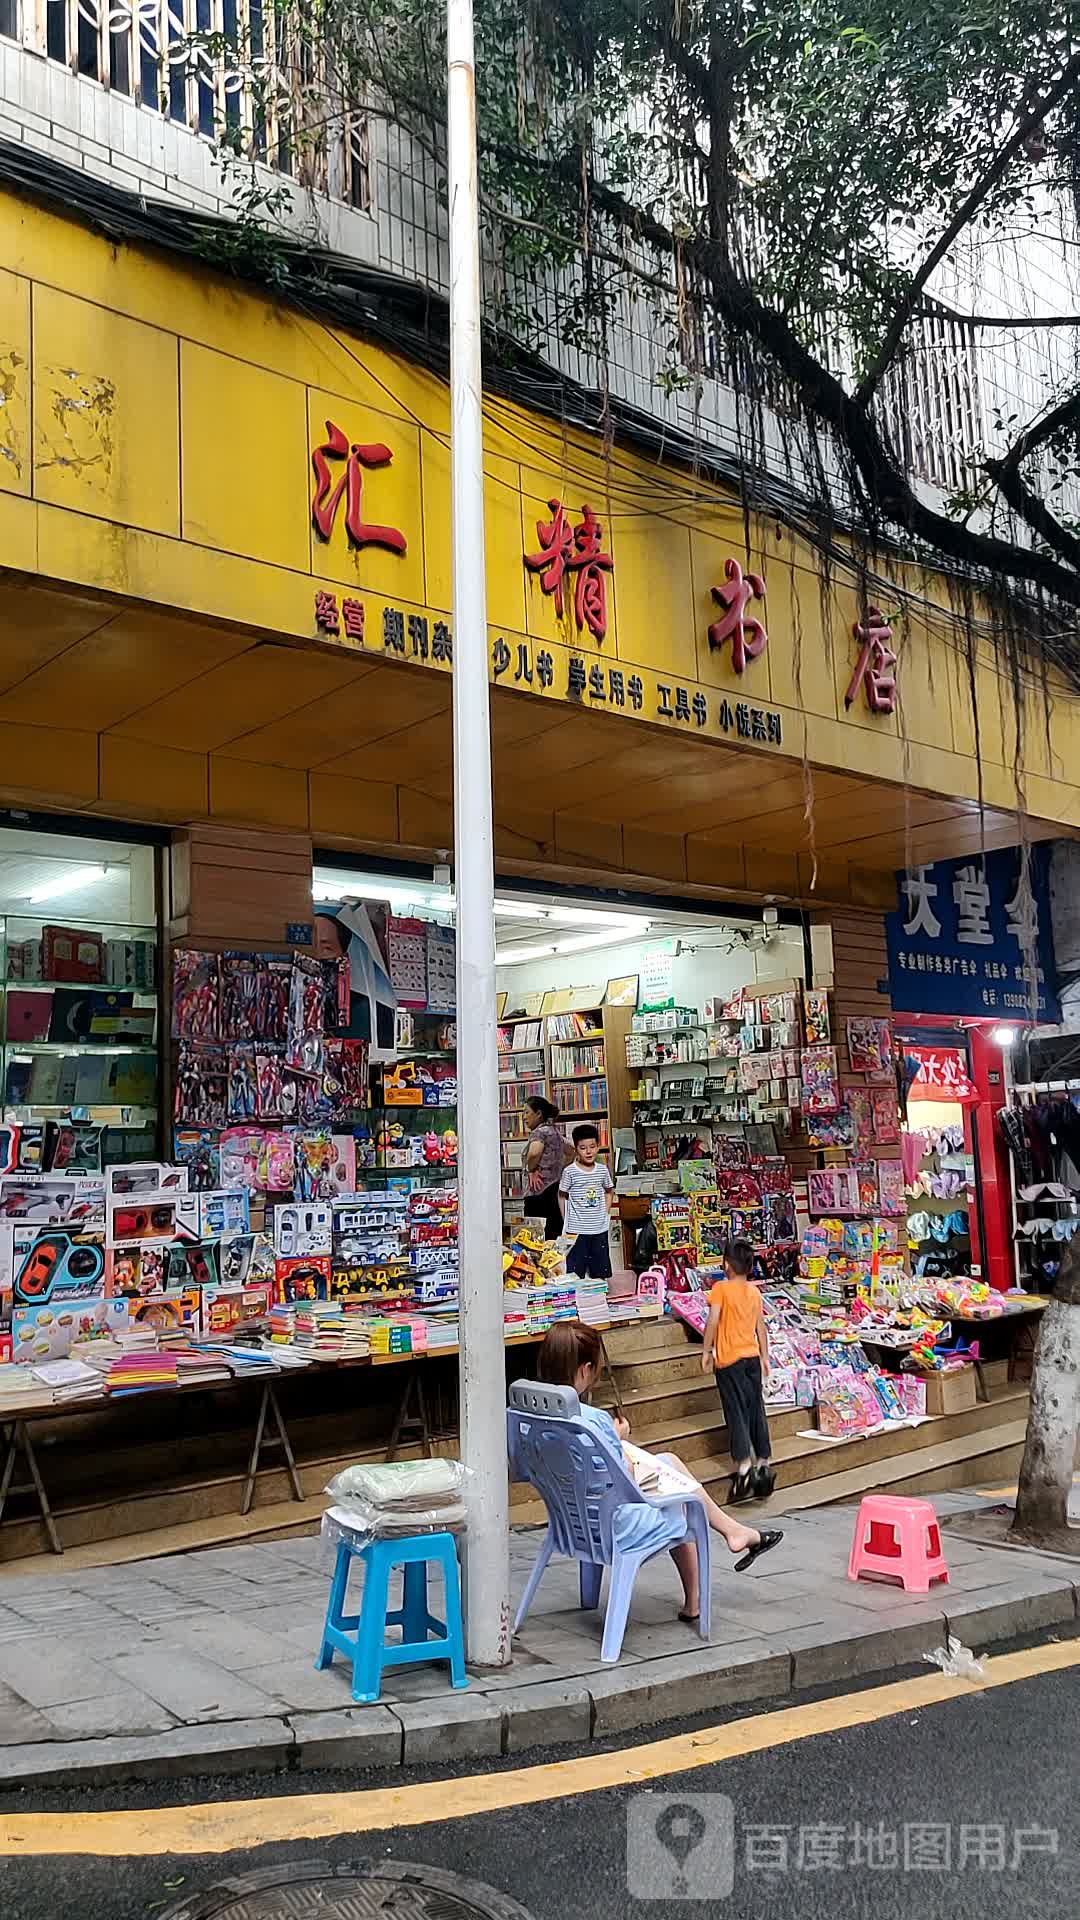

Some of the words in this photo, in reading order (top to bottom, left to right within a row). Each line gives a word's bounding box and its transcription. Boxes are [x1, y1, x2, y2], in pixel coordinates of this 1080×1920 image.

[315, 590, 364, 642] 经营
[383, 607, 453, 664] 期刊杂
[492, 637, 553, 687] 少儿书
[567, 657, 643, 710] 学生用书
[656, 683, 707, 726] 工具书
[719, 698, 782, 745] 小说系列
